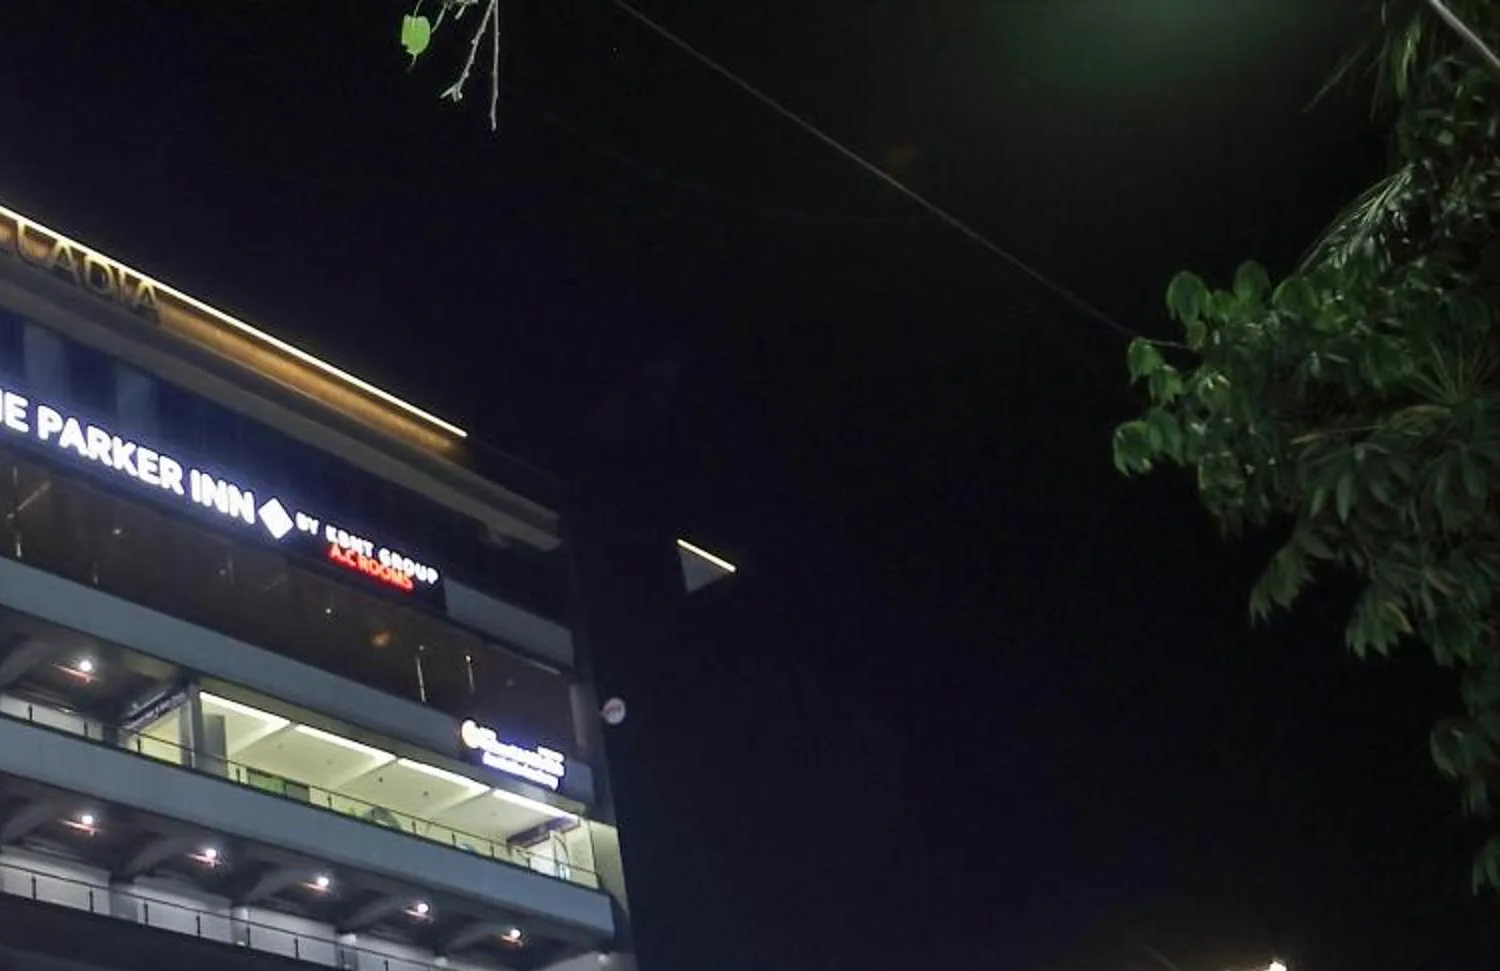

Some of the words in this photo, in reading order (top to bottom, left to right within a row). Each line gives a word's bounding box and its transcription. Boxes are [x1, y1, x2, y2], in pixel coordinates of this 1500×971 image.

[37, 405, 184, 496] PARKER
[190, 468, 257, 525] INN
[378, 548, 439, 585] GROUP
